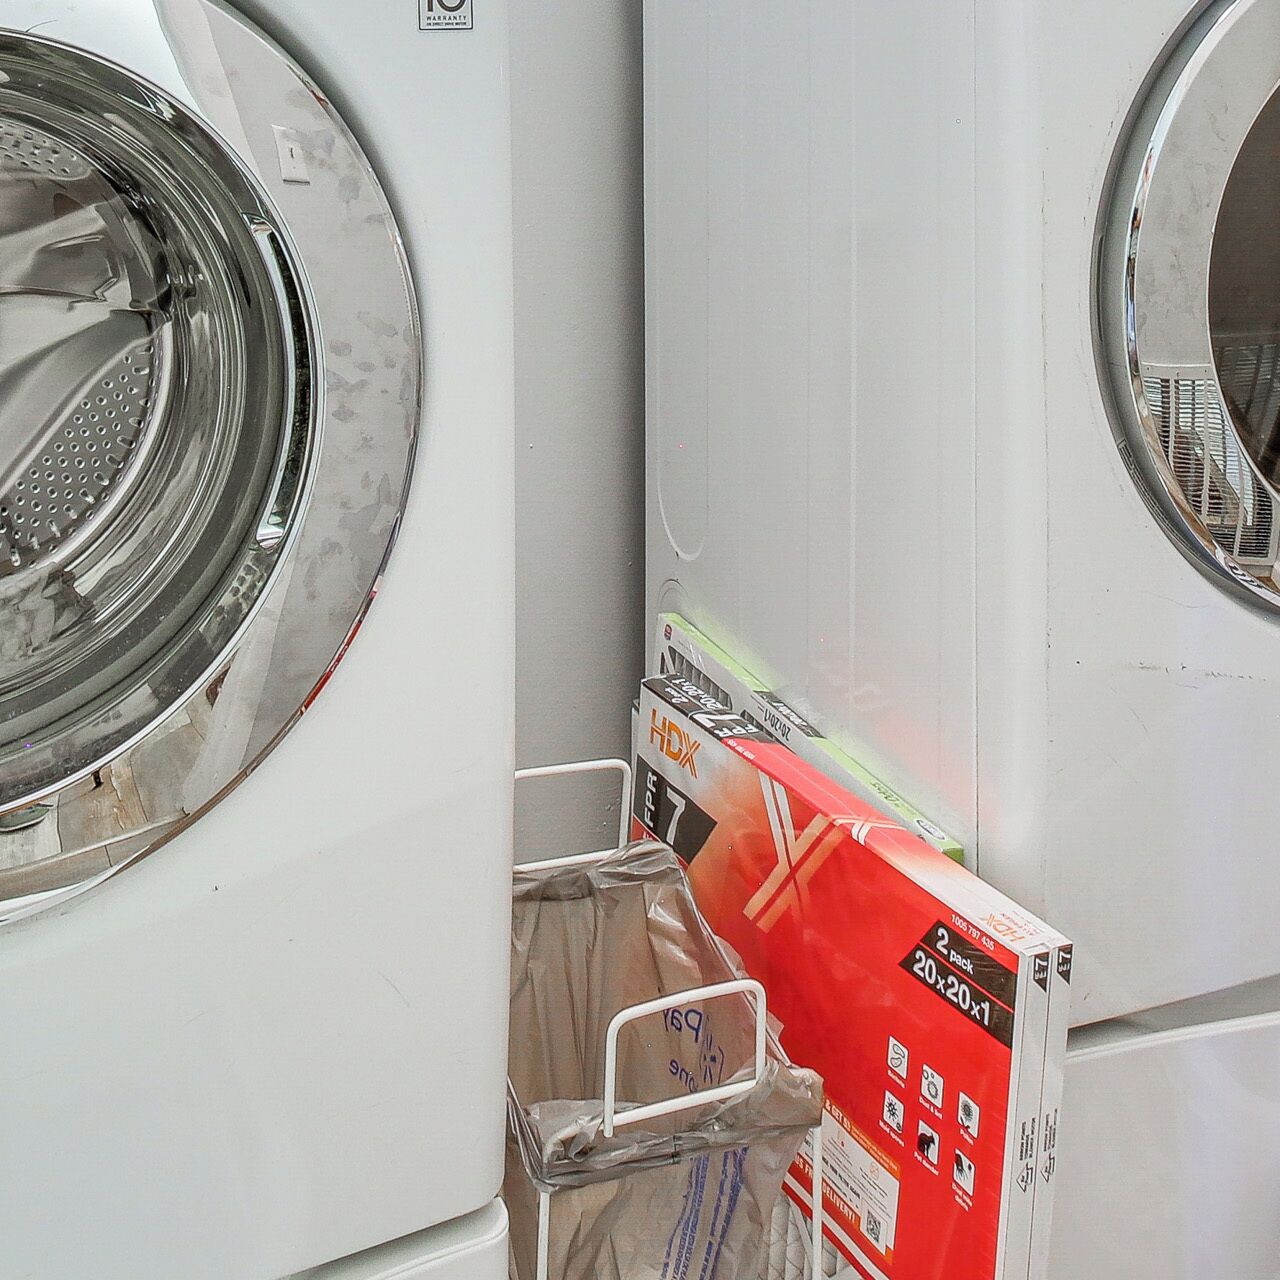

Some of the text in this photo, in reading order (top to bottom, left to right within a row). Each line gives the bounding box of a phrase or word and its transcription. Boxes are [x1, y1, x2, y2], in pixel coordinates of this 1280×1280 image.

[649, 708, 701, 780] HDX
[644, 771, 658, 828] FPR
[665, 785, 686, 846] 7
[935, 926, 974, 975] 2 pack
[951, 913, 968, 932] 1005
[967, 924, 981, 940] 797
[980, 934, 995, 951] 435
[912, 950, 991, 1026] 20x20x1
